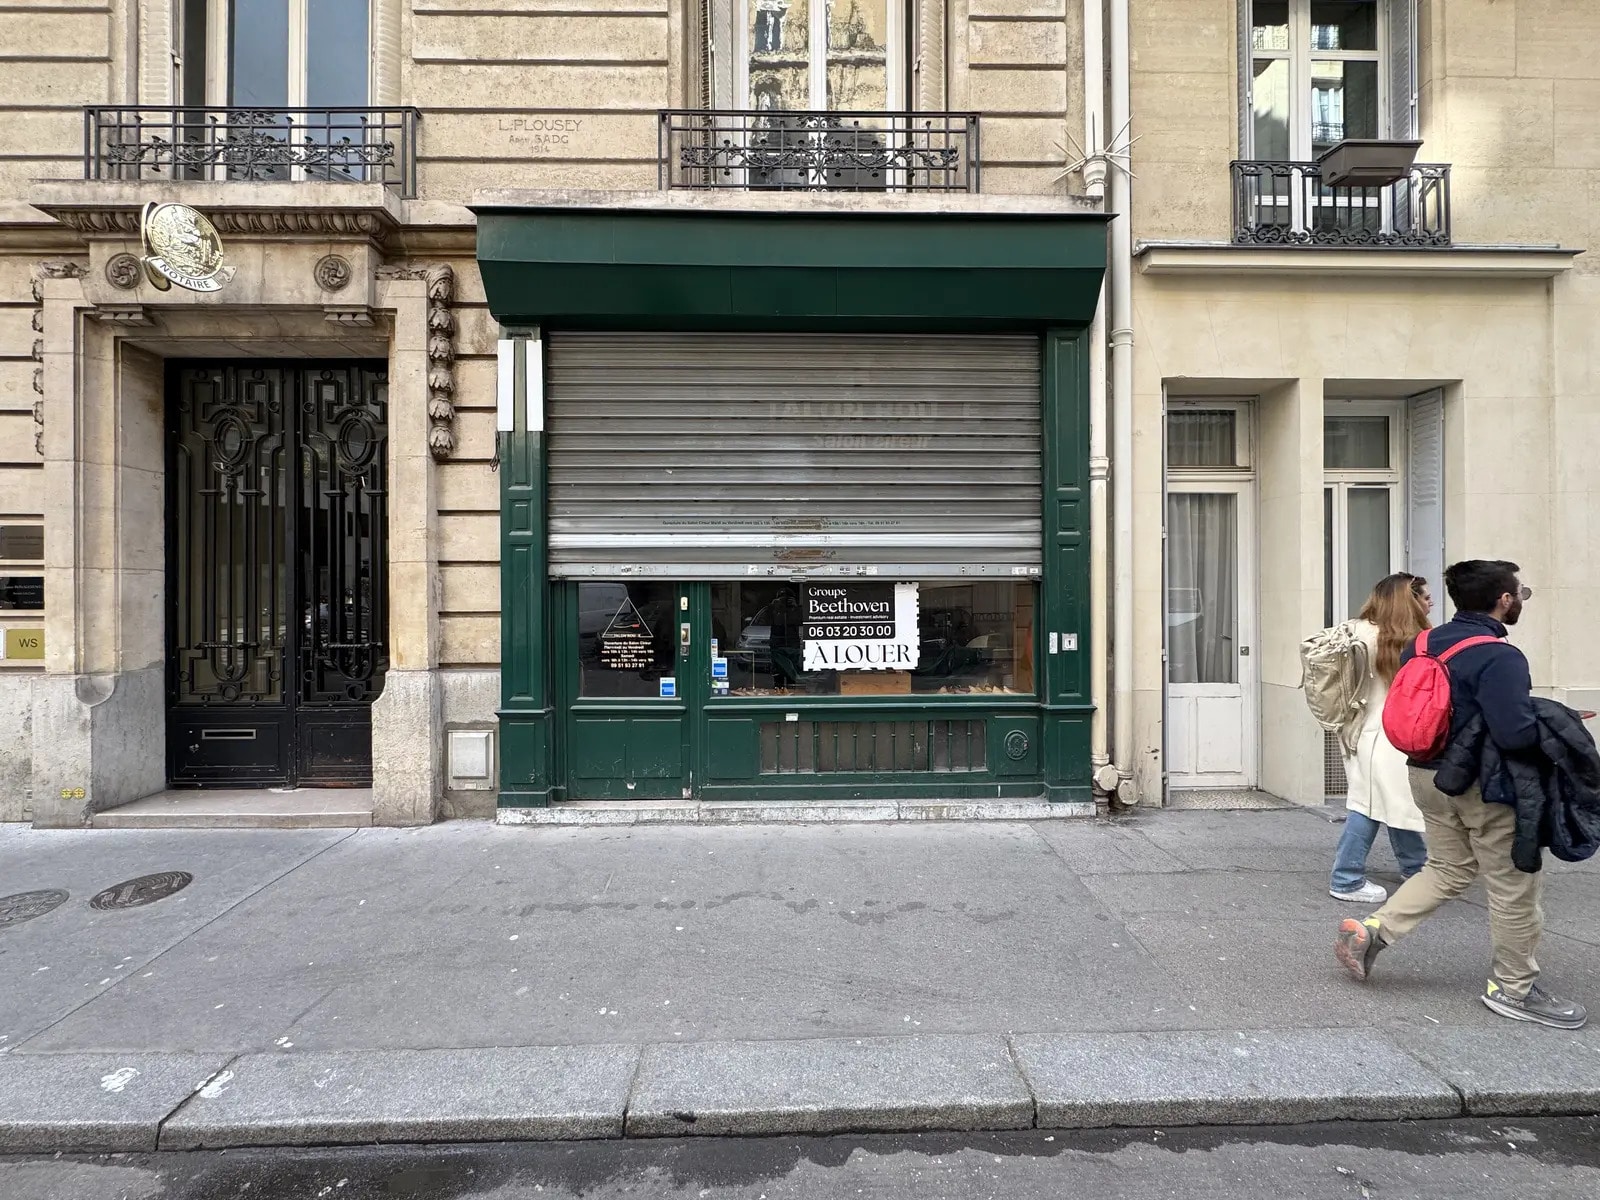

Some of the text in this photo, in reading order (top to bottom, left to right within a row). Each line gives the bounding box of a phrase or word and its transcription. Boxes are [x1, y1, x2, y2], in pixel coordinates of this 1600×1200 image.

[159, 263, 212, 290] NOTAIRE
[808, 587, 847, 599] Groupe
[808, 598, 890, 614] Beethoven
[808, 625, 892, 637] 06 03 20 30 00
[19, 638, 38, 648] WS
[811, 641, 912, 664] À LOUER
